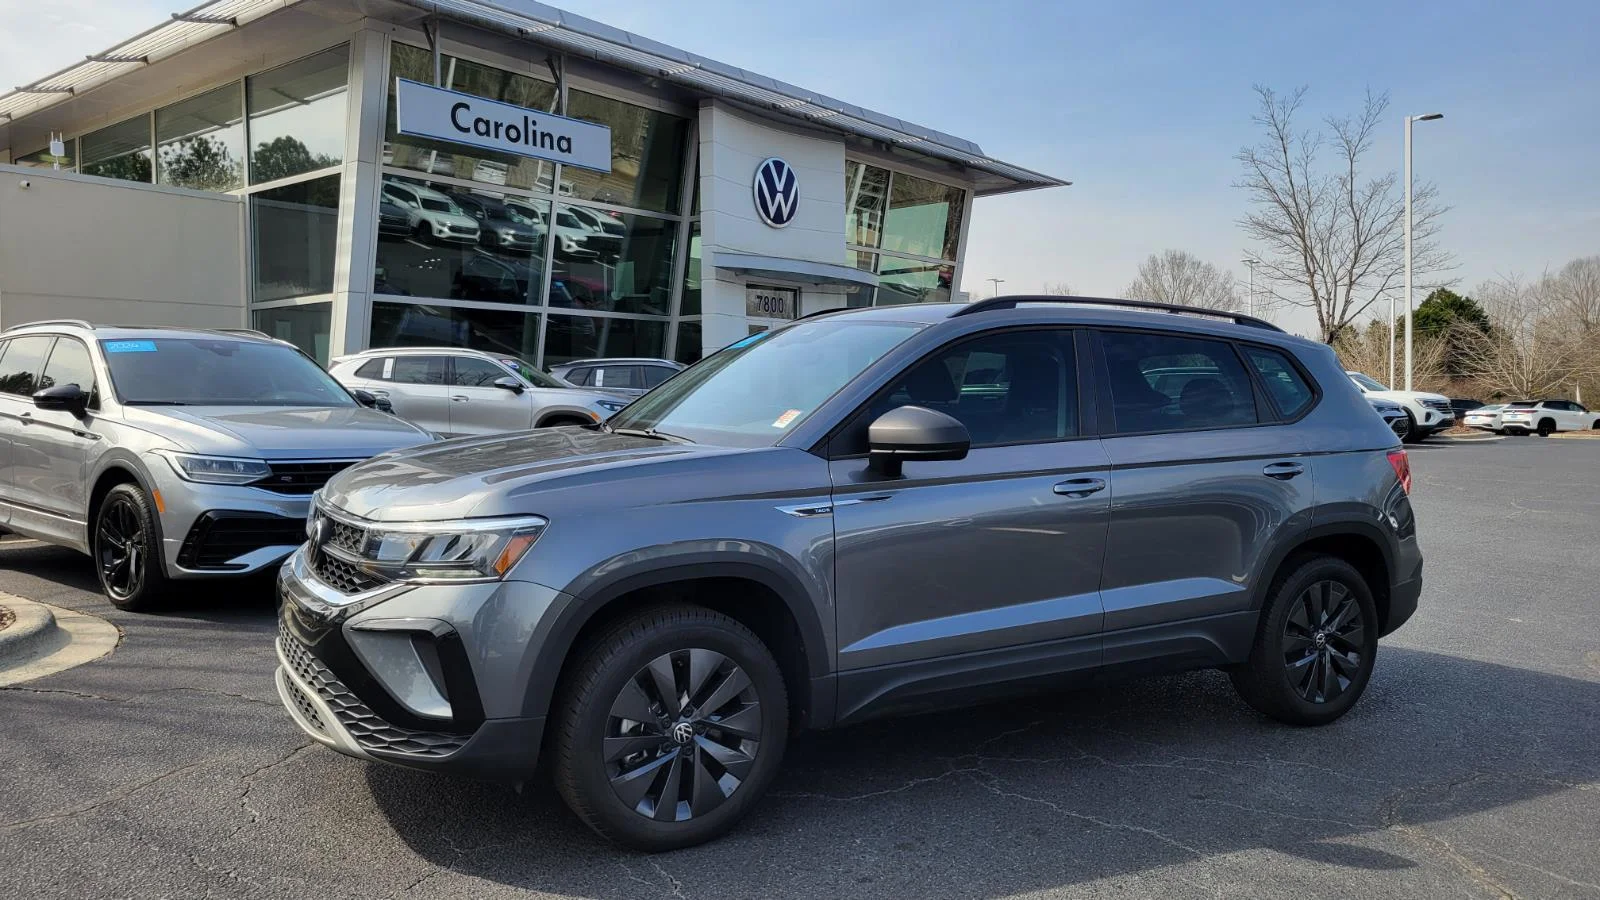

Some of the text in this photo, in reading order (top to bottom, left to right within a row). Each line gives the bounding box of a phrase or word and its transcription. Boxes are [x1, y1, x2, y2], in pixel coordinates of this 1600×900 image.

[450, 102, 573, 154] Carolina
[755, 158, 799, 226] VW
[756, 295, 784, 314] 7800
